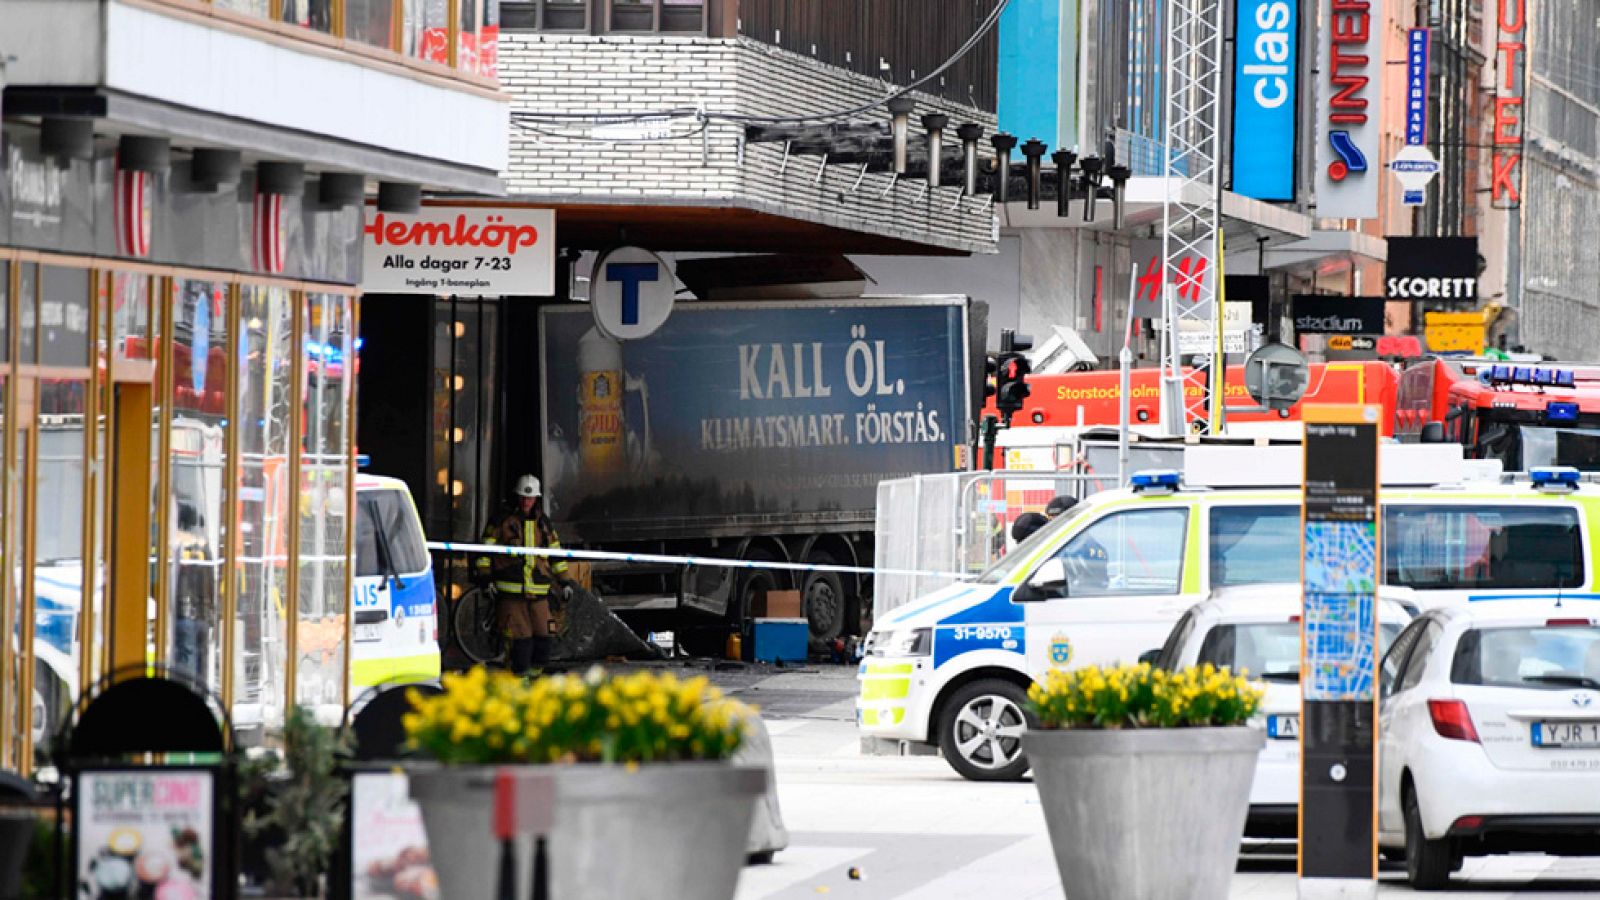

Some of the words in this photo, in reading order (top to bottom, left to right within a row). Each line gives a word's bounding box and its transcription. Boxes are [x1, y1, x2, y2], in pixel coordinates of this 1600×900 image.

[1243, 2, 1289, 109] clas
[383, 255, 414, 269] Alla
[420, 255, 469, 273] dagar
[474, 257, 512, 270] 7-23
[606, 262, 659, 325] T
[1387, 277, 1476, 298] SCORETT
[1296, 315, 1363, 331] stadium
[738, 342, 832, 400] KALL
[845, 324, 905, 396] ÖL.
[701, 413, 849, 449] KLIMATSMART.
[855, 401, 945, 444] FÖRSTÅS.
[954, 627, 1012, 640] 31-9570
[1547, 723, 1583, 742] YJR
